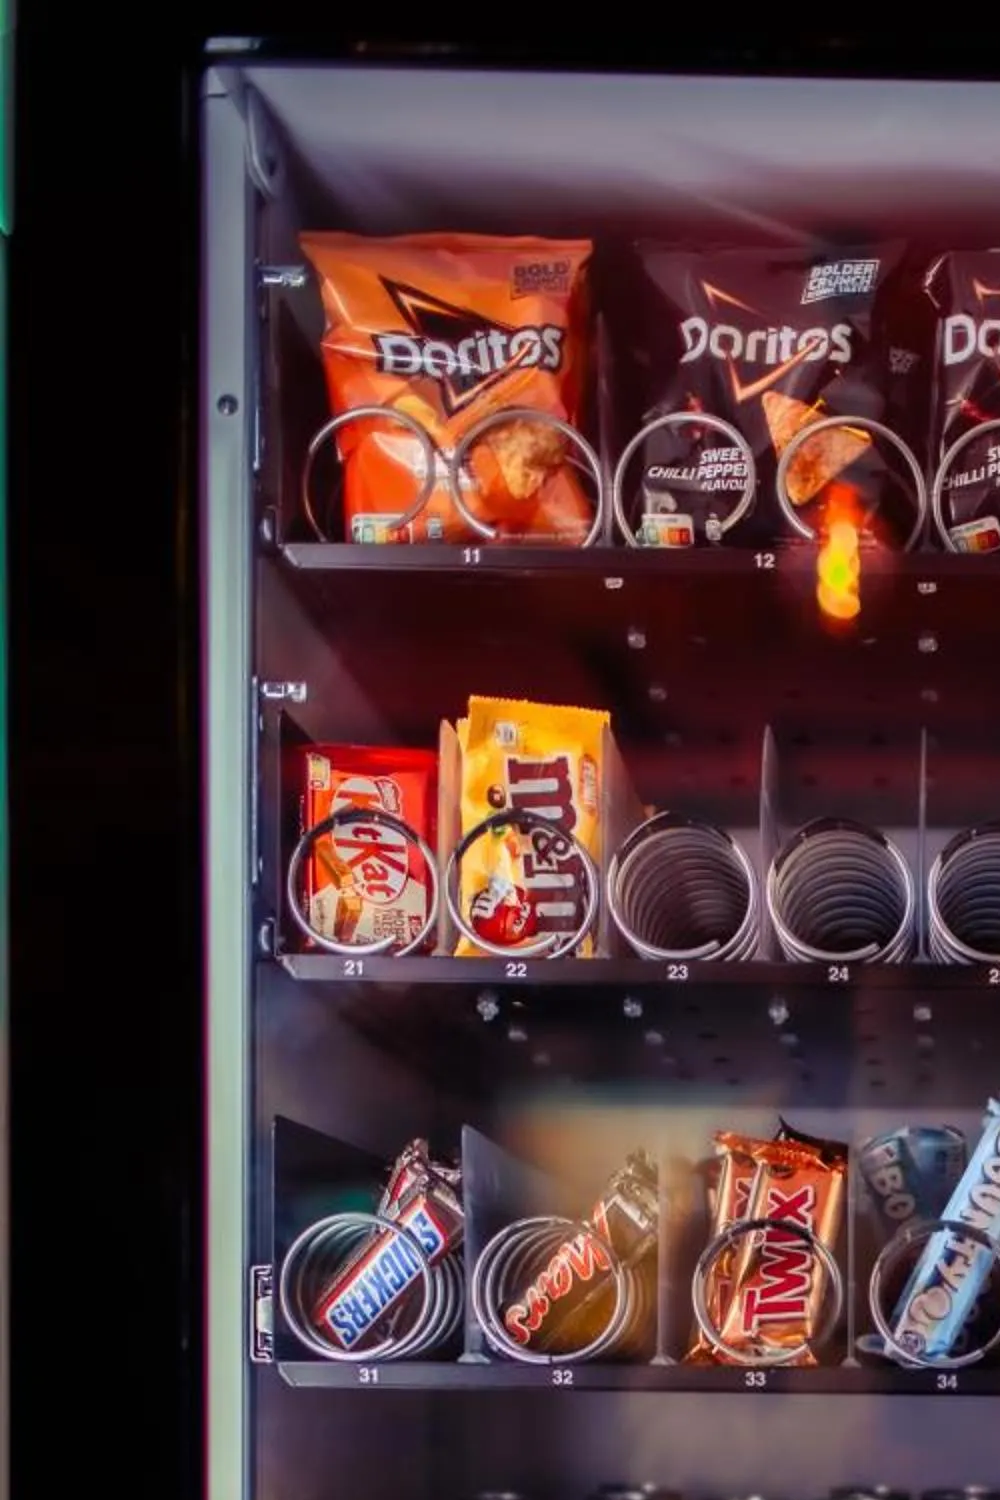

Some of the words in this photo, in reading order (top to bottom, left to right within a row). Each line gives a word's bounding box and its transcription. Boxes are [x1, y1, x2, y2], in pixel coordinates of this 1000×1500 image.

[679, 316, 853, 364] Doritos
[378, 327, 562, 378] Doritos
[700, 447, 748, 465] SWEE
[647, 466, 696, 480] CHILLI
[697, 463, 748, 479] PEPPE
[701, 479, 749, 491] FLAVOU
[463, 547, 480, 563] 11
[754, 553, 775, 569] 12
[344, 959, 363, 976] 21
[506, 962, 527, 978] 22
[667, 964, 689, 980] 23
[828, 966, 849, 981] 24
[359, 1367, 378, 1383] 31
[552, 1369, 573, 1385] 32
[745, 1371, 766, 1387] 33
[937, 1374, 958, 1389] 34
